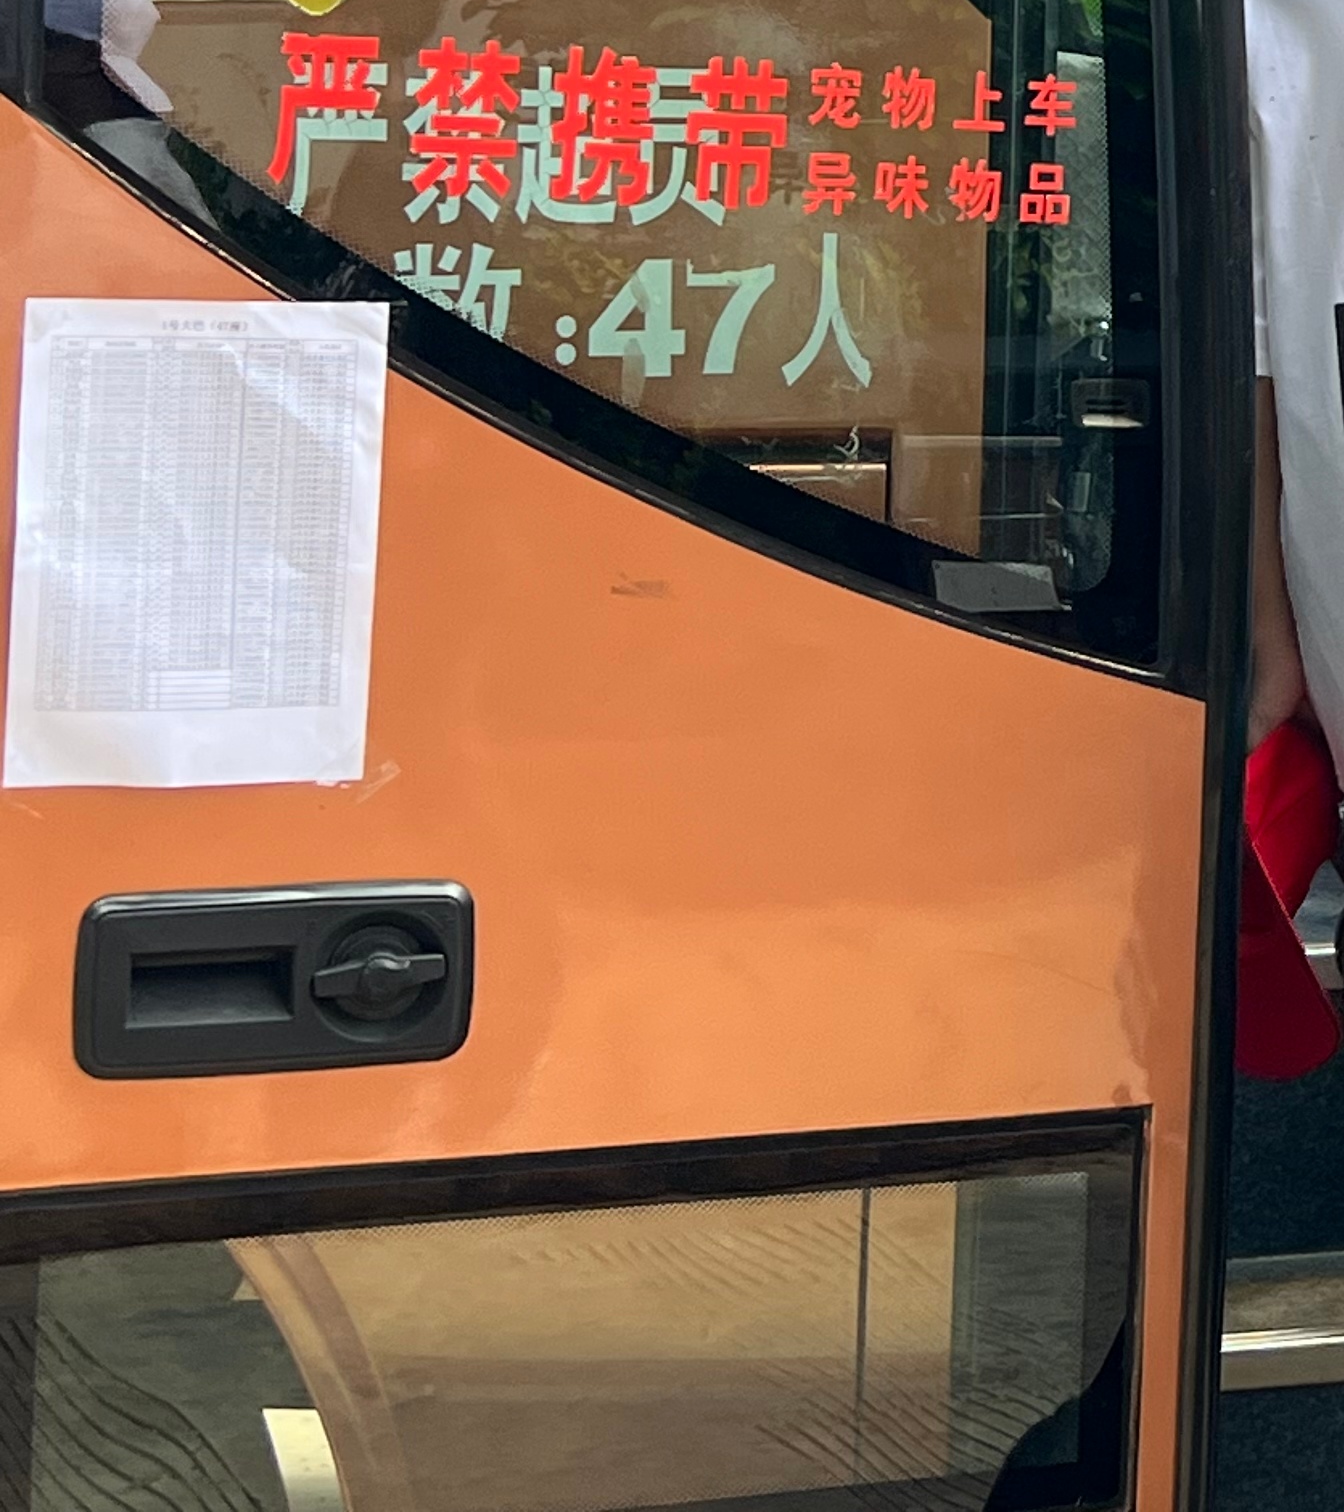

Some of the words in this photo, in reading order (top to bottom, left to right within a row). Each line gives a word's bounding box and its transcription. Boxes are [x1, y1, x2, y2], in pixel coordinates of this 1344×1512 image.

[266, 31, 790, 210] 严禁携带
[807, 61, 1078, 137] 宠物上车
[801, 151, 1072, 225] 异味物品
